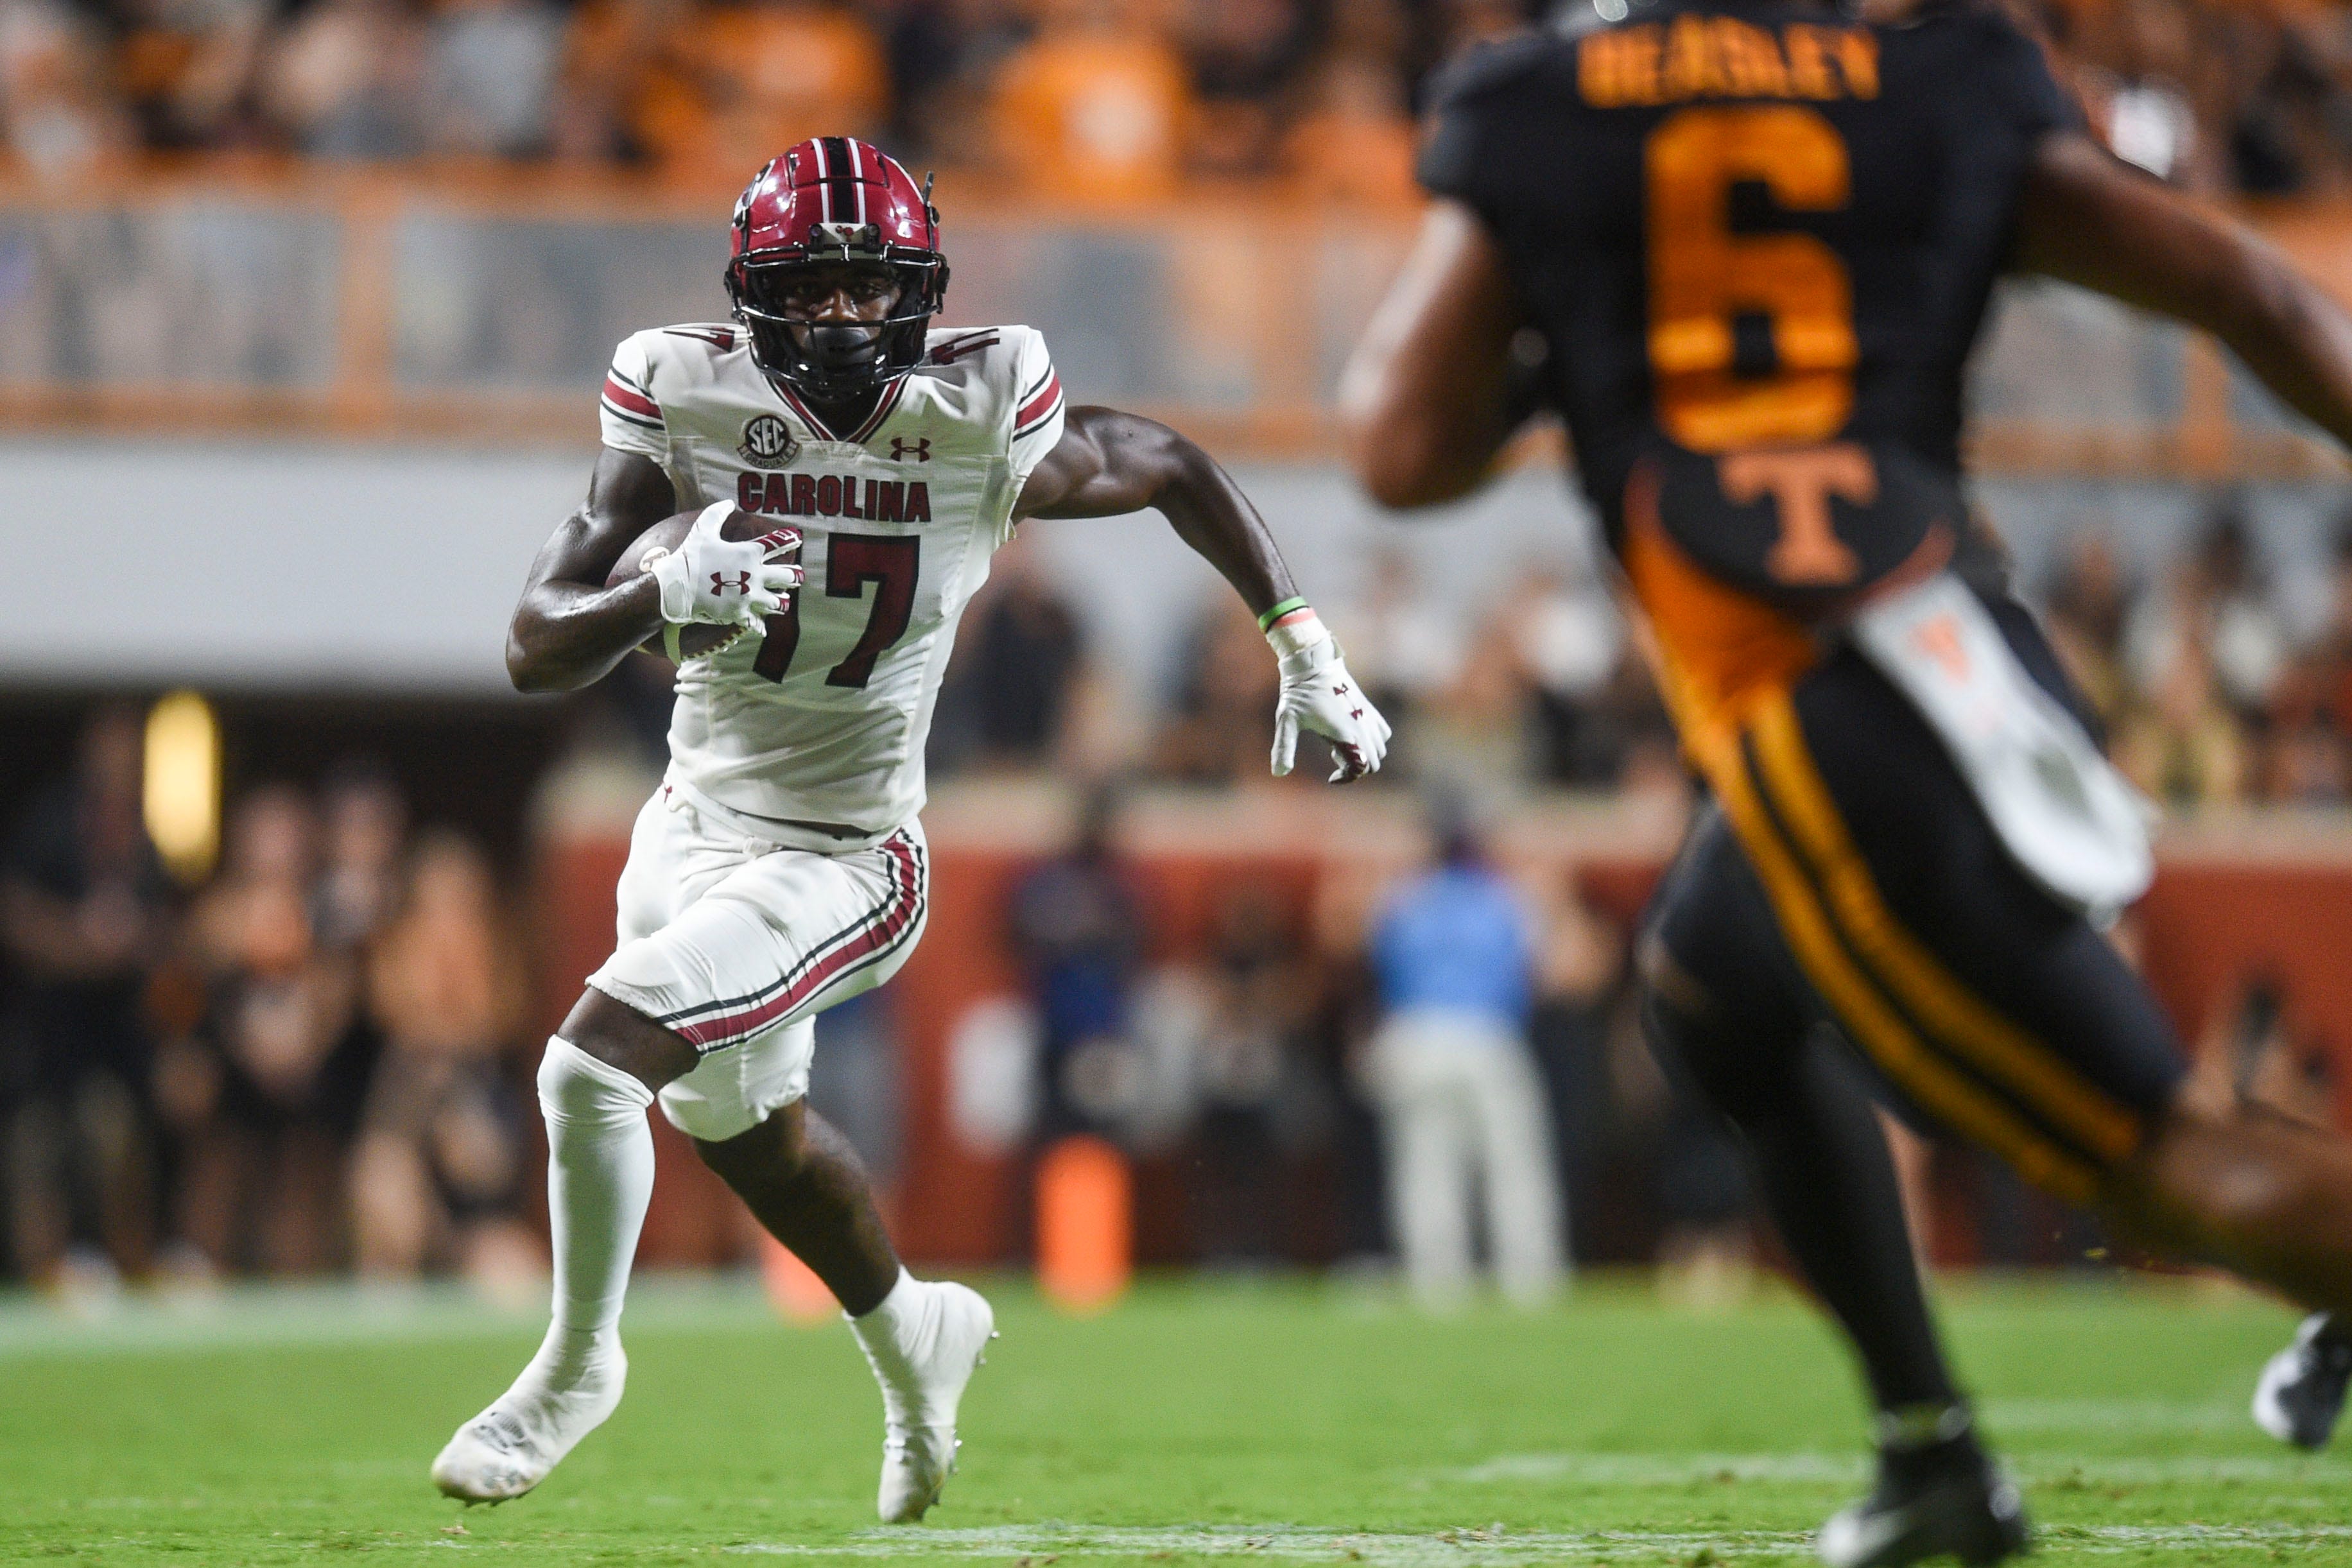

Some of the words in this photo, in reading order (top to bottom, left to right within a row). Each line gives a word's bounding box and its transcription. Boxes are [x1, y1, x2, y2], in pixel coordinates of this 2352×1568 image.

[1645, 104, 1858, 452] 6
[738, 472, 931, 522] CAROLINA
[748, 418, 784, 454] SEC
[1718, 443, 1878, 585] T
[753, 529, 921, 688] 17
